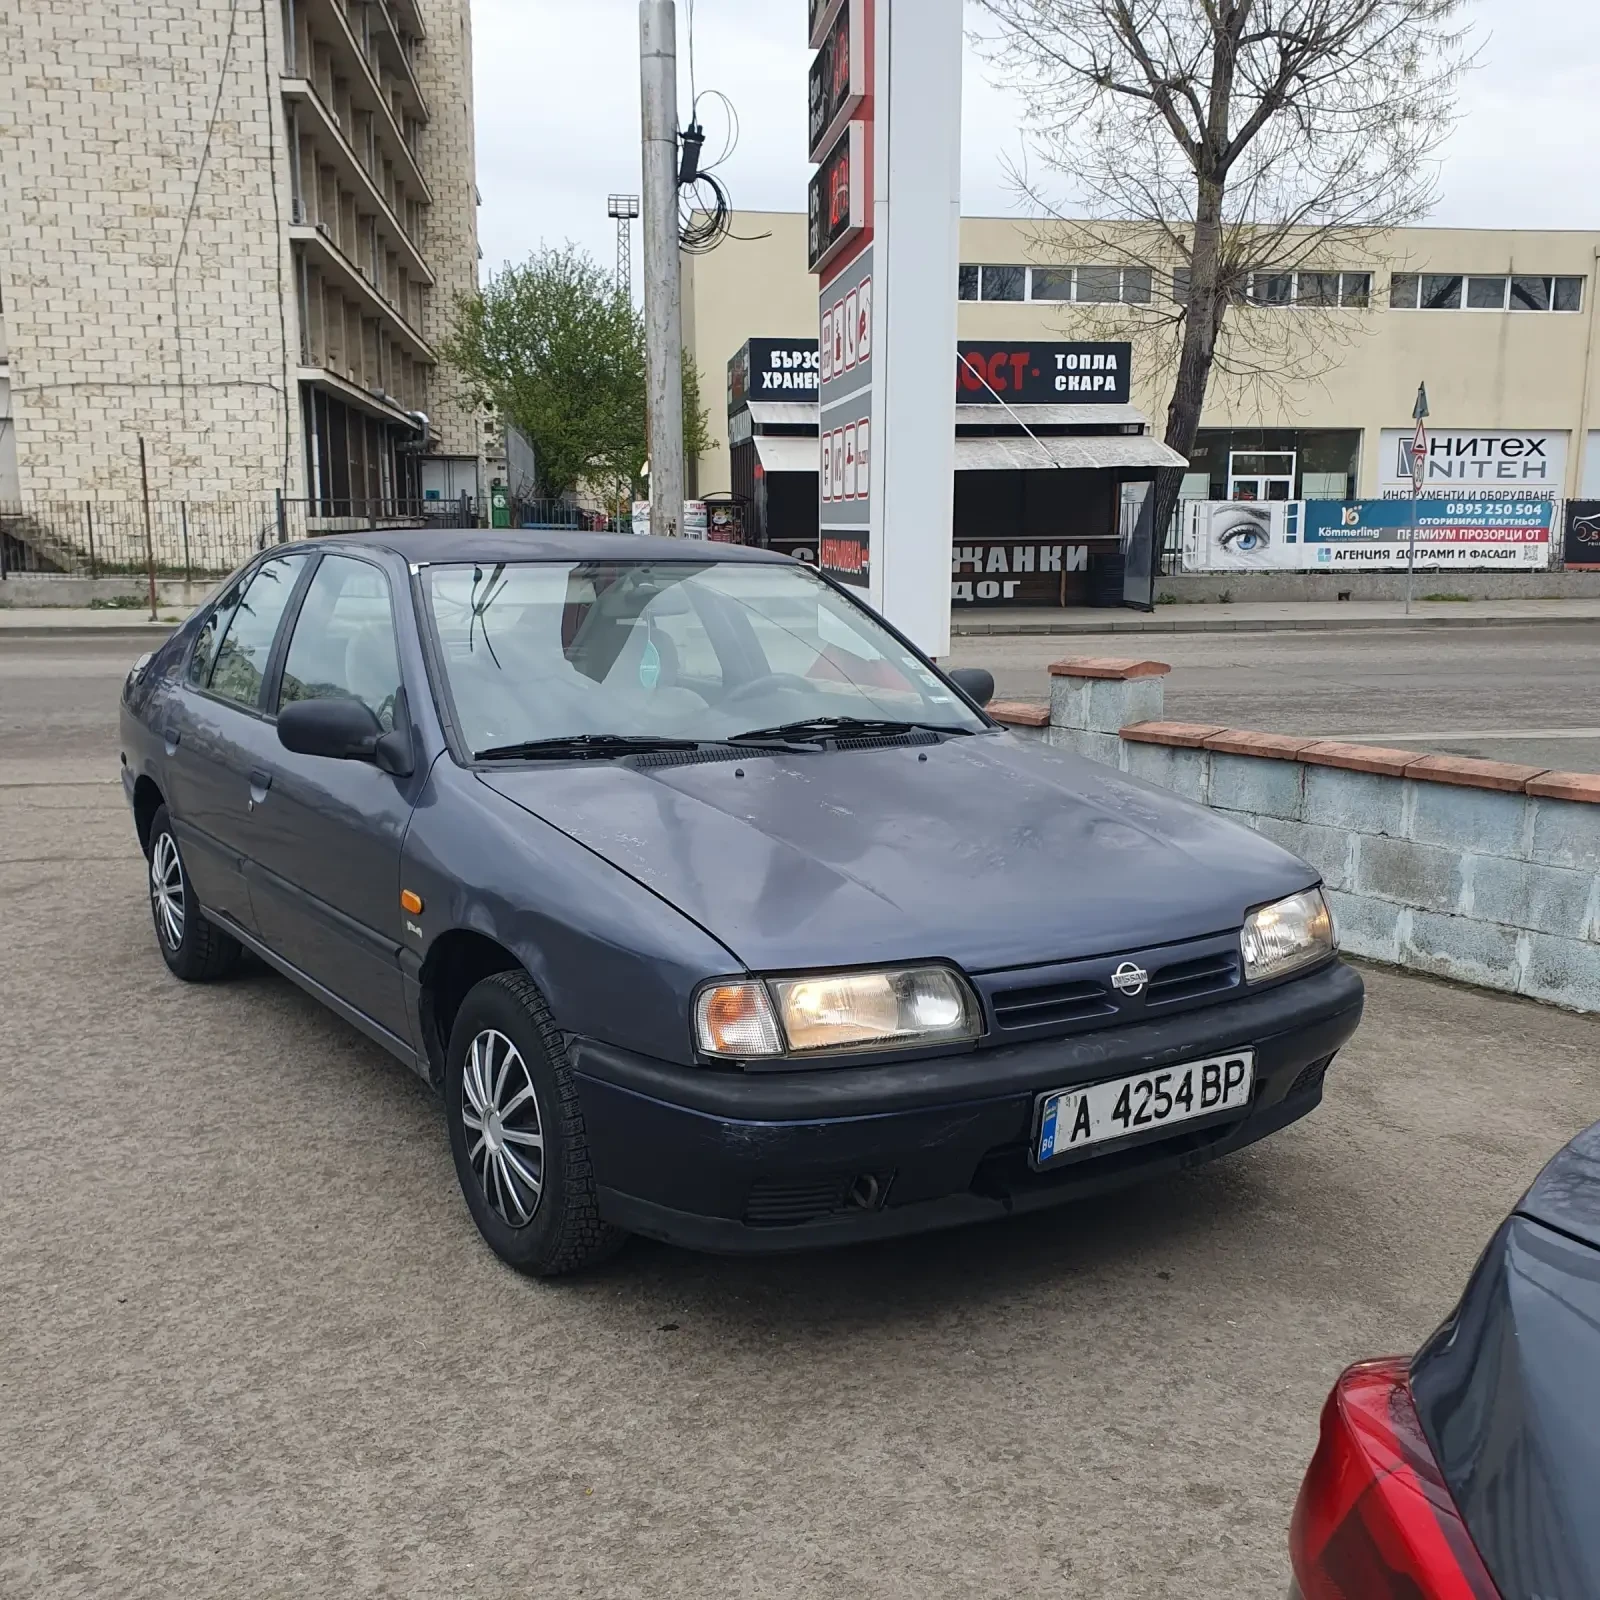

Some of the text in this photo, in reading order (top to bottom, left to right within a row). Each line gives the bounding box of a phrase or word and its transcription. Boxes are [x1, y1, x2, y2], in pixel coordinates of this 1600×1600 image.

[1054, 353, 1118, 370] ТОПЛА
[1054, 375, 1117, 391] СКАРА
[1428, 460, 1547, 479] NITEH
[1468, 490, 1476, 500] И
[1479, 490, 1556, 501] ОБОРУДВАНЕ
[1446, 503, 1542, 515] 0895 250 504
[1418, 517, 1542, 526] ОТОРИЗИРАН ПАРТНЬОР
[1318, 527, 1380, 539] Kömmerling
[1397, 529, 1541, 541] ПРЕМИУМ ПРОЗОРЦИ ОТ
[1334, 550, 1390, 560] АГЕНЦИЯ
[1458, 550, 1466, 559] И
[1469, 550, 1517, 559] ФАСАДИ
[951, 580, 1021, 602] ДОГ
[1113, 972, 1147, 985] NISSAN
[1070, 1095, 1091, 1142] A
[1042, 1136, 1054, 1152] BG
